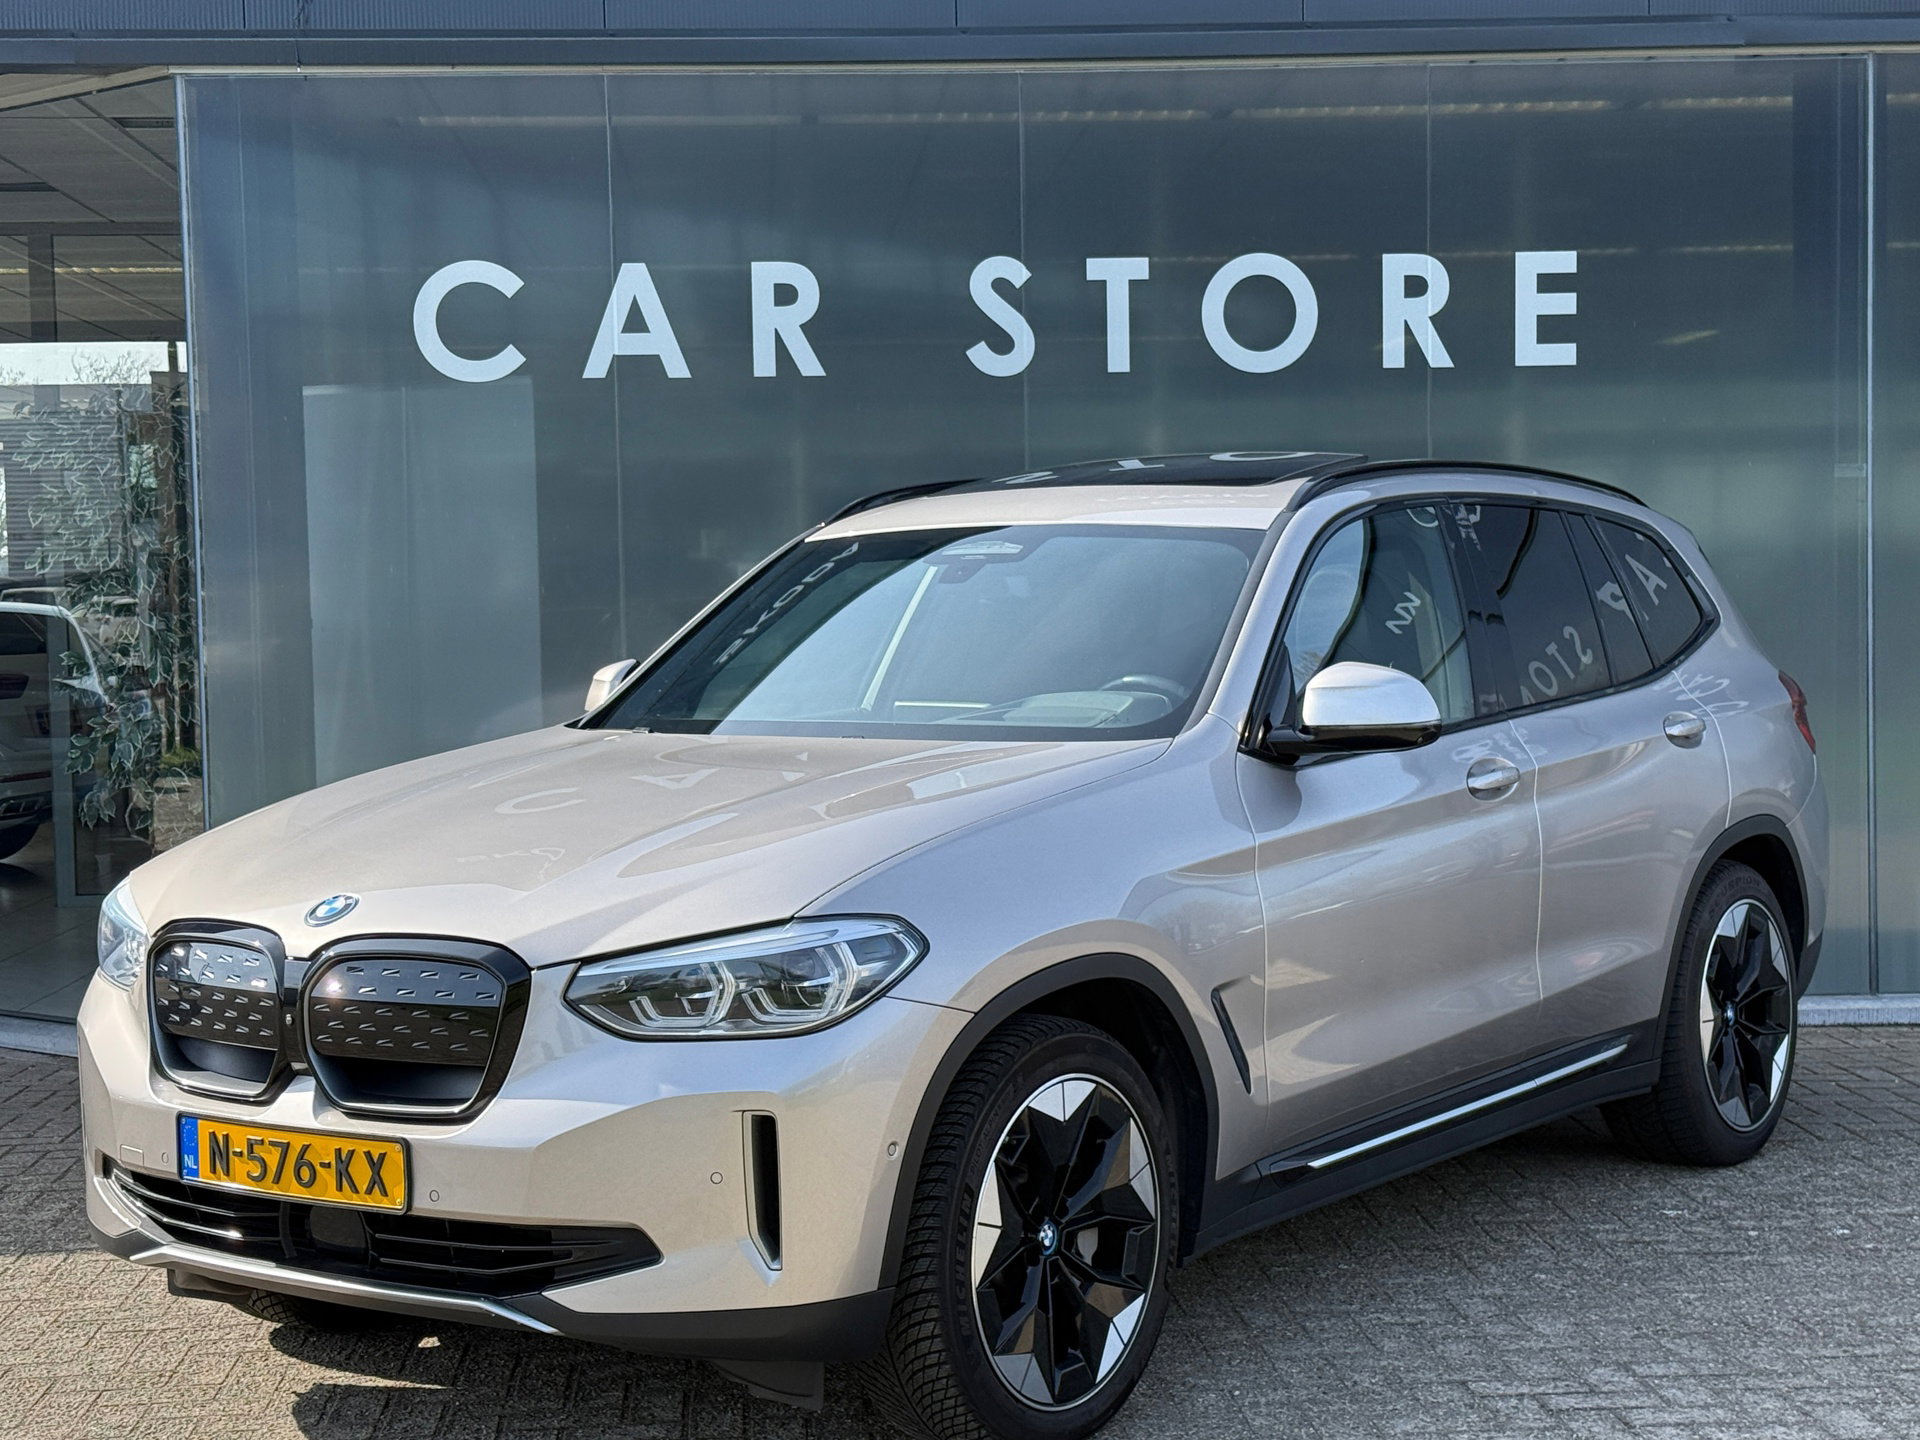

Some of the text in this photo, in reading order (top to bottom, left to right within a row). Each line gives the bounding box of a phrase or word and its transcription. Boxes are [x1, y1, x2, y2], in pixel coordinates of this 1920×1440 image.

[413, 250, 1579, 383] CAR STORE
[184, 1154, 198, 1169] NL
[209, 1130, 388, 1197] N-576-KX
[956, 1191, 974, 1338] MICHELIN
